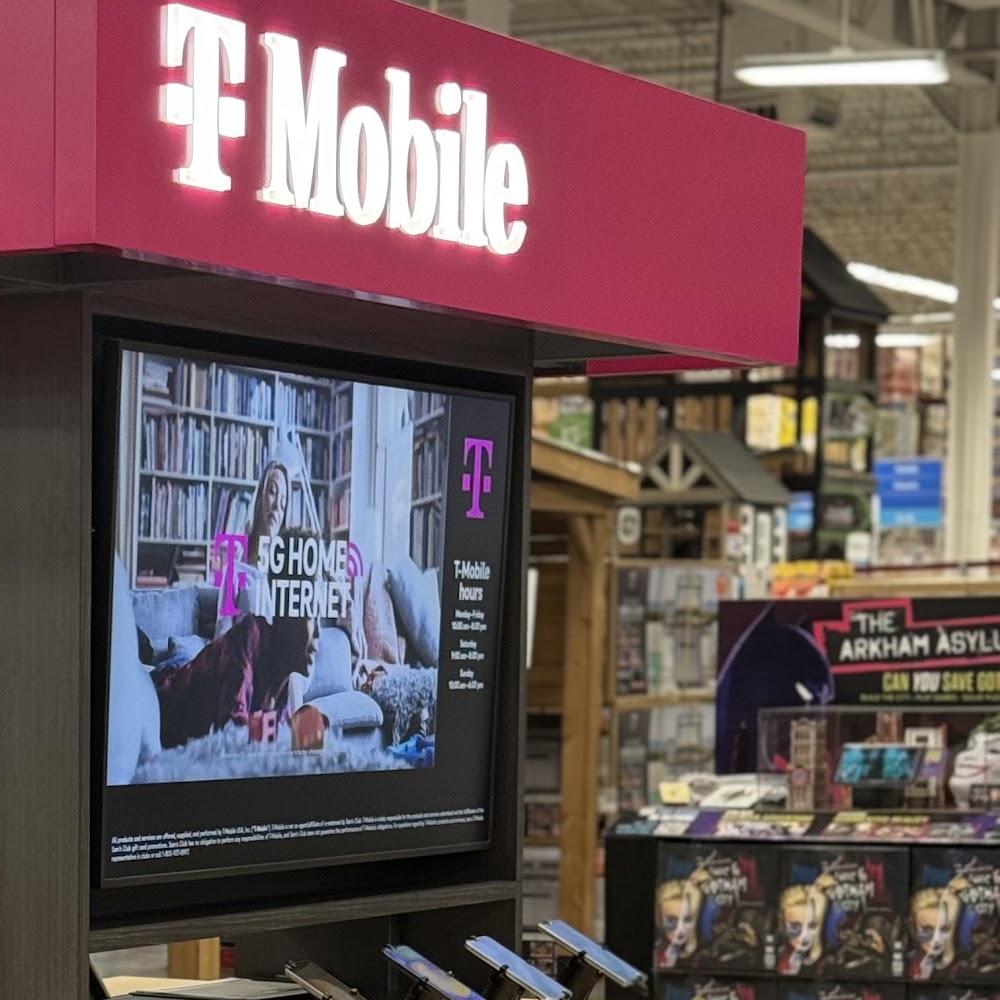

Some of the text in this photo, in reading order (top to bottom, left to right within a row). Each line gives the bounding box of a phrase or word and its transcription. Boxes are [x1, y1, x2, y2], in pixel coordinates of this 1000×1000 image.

[257, 31, 530, 256] Mobile
[257, 535, 349, 577] 5G HOME
[453, 560, 490, 580] T-Mobile
[254, 578, 351, 619] INTERNET
[459, 581, 483, 601] hours
[851, 611, 896, 635] THE
[839, 633, 930, 662] ARKHAM
[882, 672, 910, 692] CAN
[913, 671, 940, 692] YOU
[942, 670, 974, 692] SAVE
